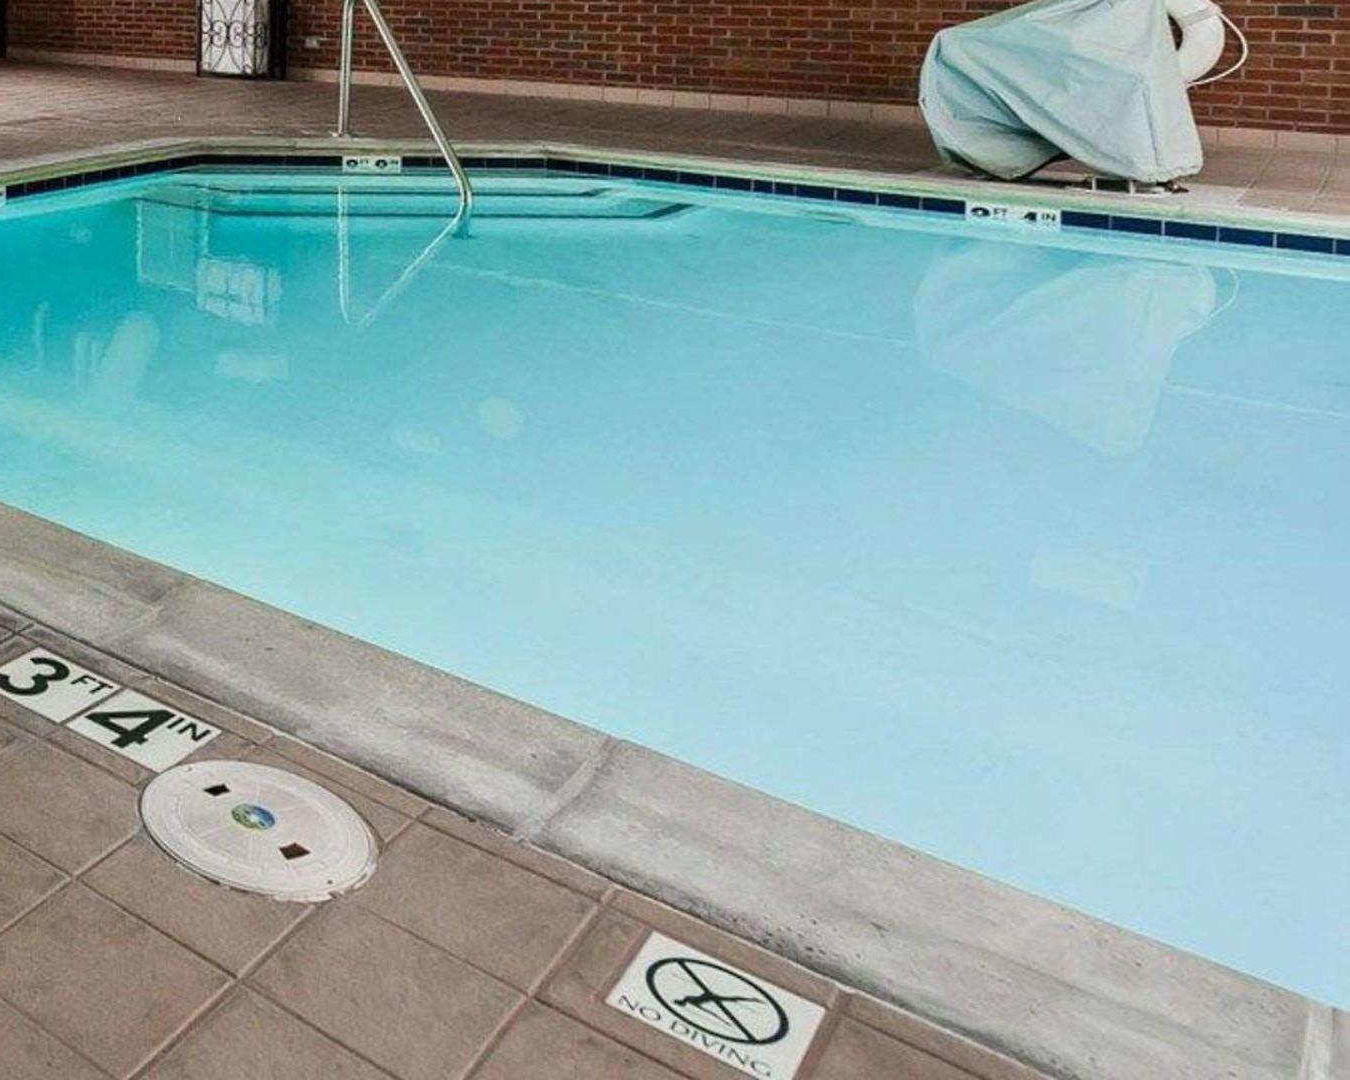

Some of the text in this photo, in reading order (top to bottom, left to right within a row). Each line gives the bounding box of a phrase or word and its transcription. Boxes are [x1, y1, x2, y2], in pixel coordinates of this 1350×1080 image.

[70, 673, 115, 695] FT
[84, 708, 176, 749] 4
[167, 716, 211, 743] IN
[618, 994, 773, 1078] NO DIVING
